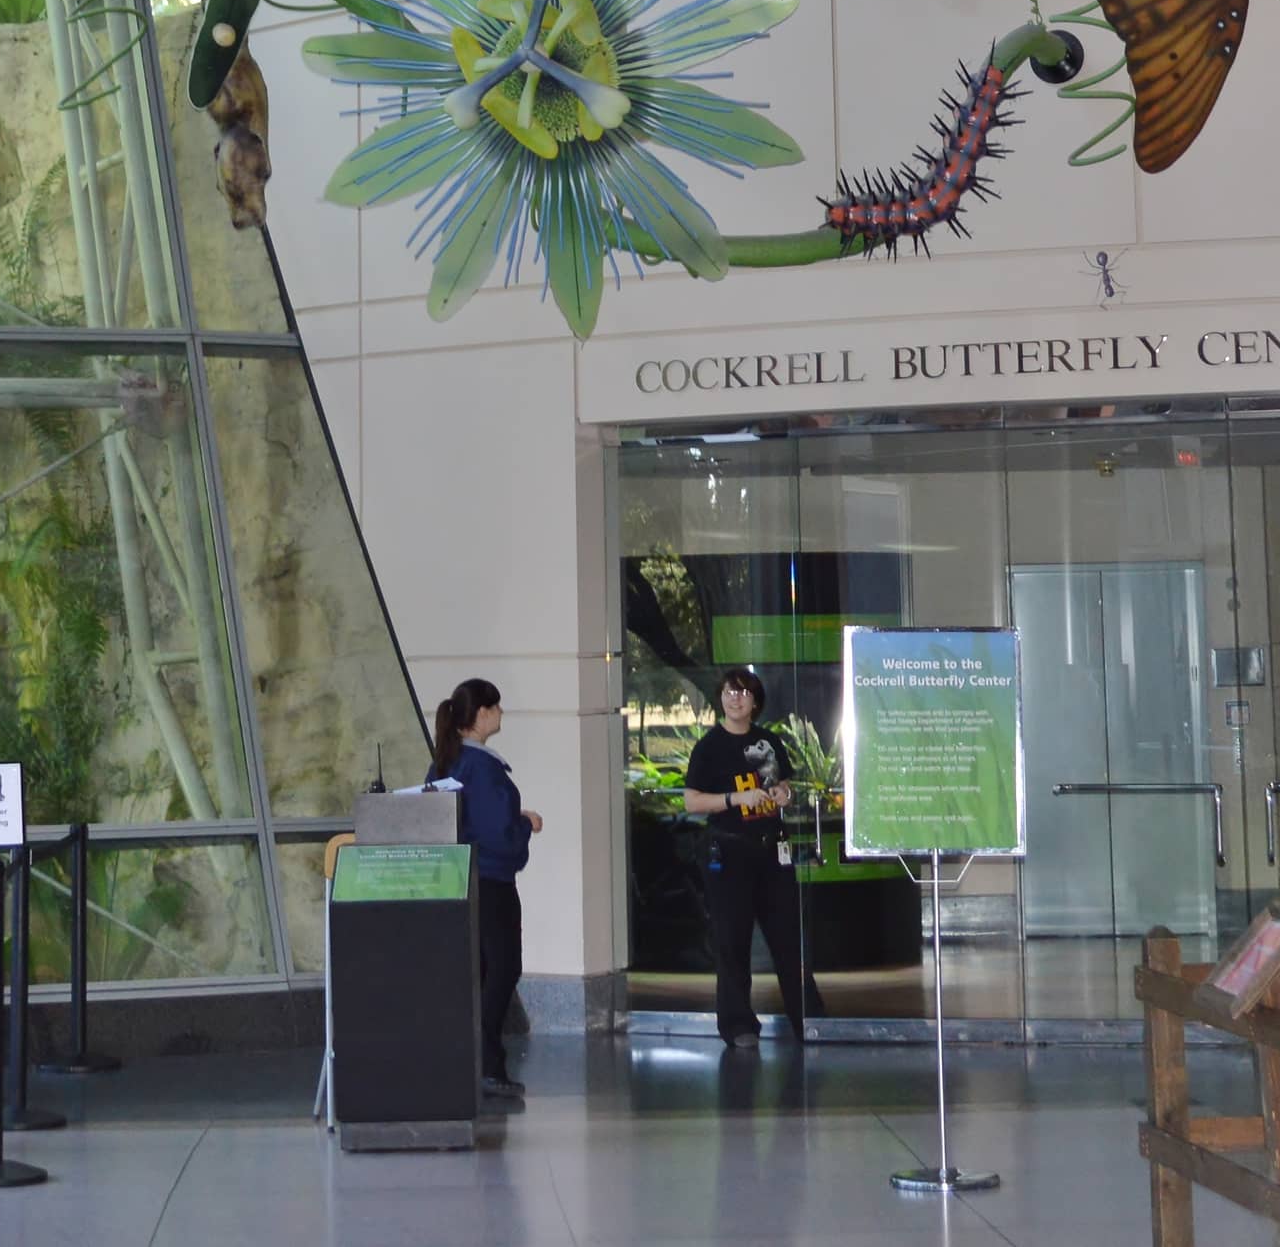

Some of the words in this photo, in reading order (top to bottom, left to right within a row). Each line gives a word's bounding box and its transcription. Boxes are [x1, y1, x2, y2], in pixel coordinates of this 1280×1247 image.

[634, 350, 867, 394] COCKRELL
[889, 334, 1169, 381] BUTTERFLY
[882, 658, 940, 670] Welcome
[944, 659, 957, 670] to
[961, 658, 983, 670] the
[854, 675, 905, 687] Cockrell
[908, 674, 965, 689] Butterfly
[969, 675, 1012, 687] Center
